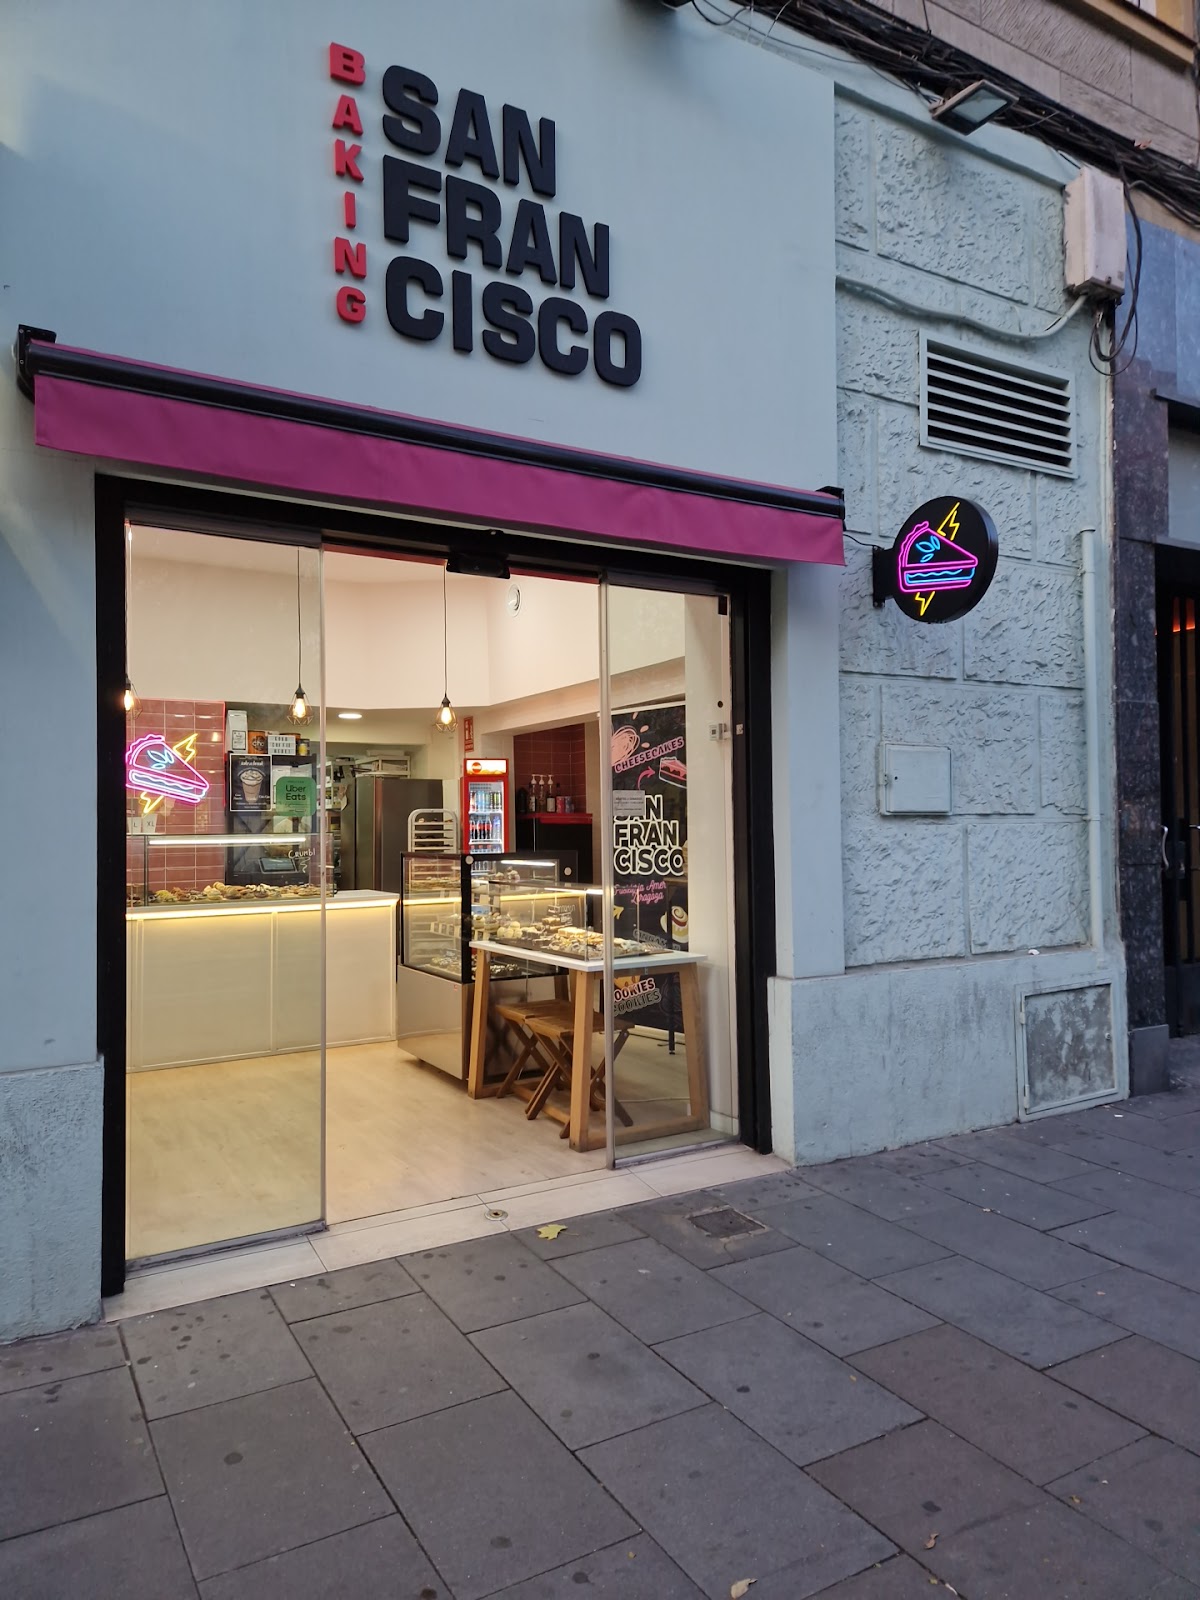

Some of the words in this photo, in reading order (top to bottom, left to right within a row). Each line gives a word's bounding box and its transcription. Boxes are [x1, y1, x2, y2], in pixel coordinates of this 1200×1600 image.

[382, 65, 556, 198] SAN
[329, 42, 366, 324] BAKING
[383, 154, 610, 300] FRAN
[385, 256, 642, 388] CISCO
[614, 736, 684, 773] CHEESECAKES
[285, 784, 306, 793] Uber
[285, 793, 307, 801] Eats
[614, 820, 679, 848] FRAN
[614, 847, 685, 876] CISCO
[614, 978, 656, 1003] OOKIES
